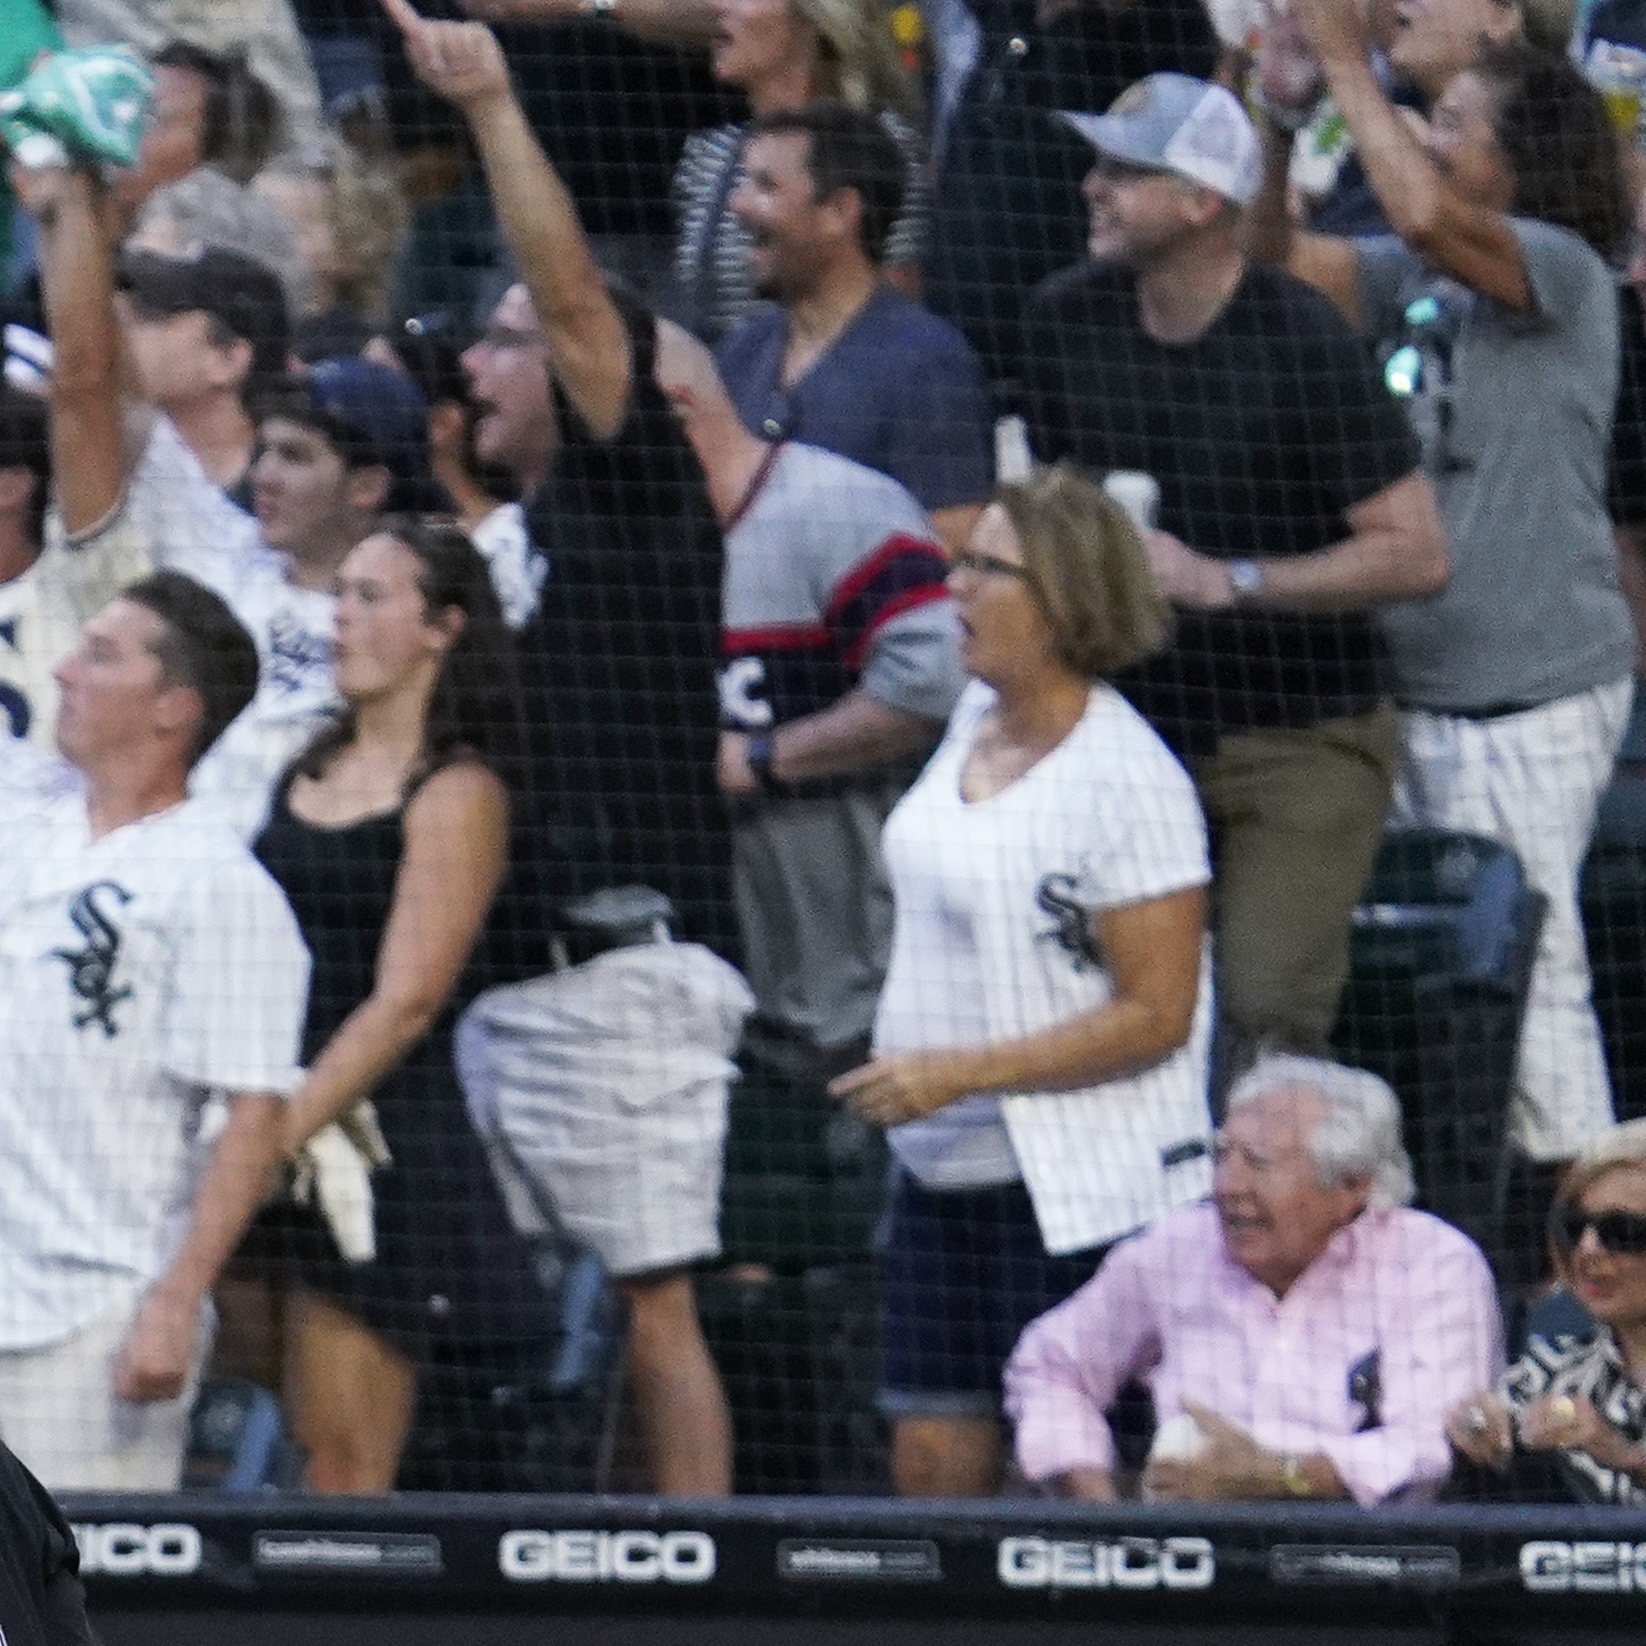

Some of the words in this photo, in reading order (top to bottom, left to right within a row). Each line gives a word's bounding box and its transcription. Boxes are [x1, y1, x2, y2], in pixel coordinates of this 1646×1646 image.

[71, 1522, 203, 1575] ICO
[498, 1529, 717, 1583] GEICO
[996, 1534, 1216, 1589] GEICO
[1518, 1540, 1646, 1592] GEI
